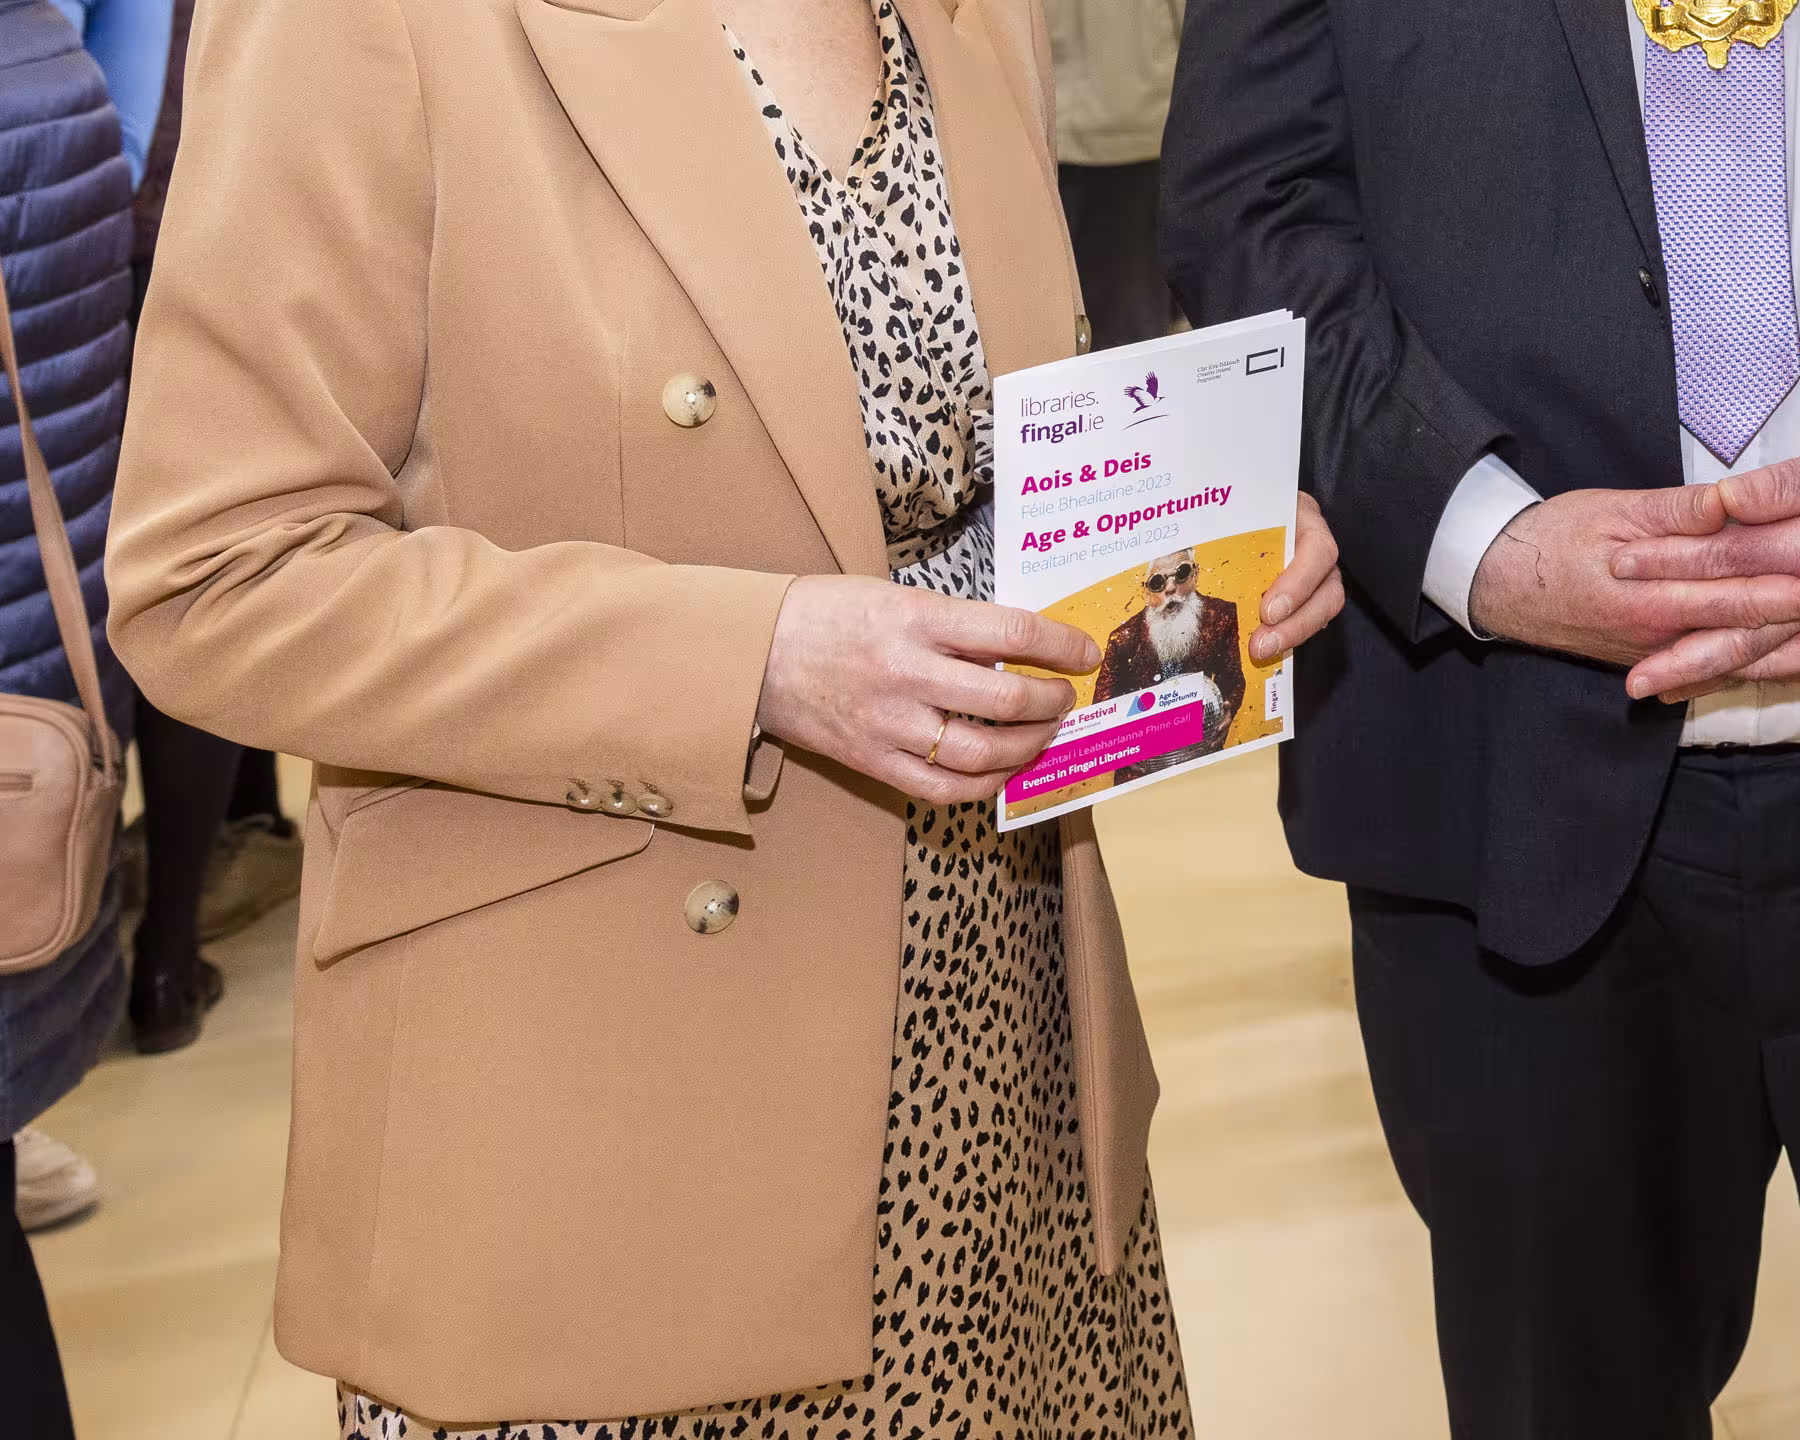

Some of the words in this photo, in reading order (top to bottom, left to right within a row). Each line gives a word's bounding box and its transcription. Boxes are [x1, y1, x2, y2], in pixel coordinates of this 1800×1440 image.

[1021, 391, 1100, 418] libraries.
[1020, 413, 1104, 444] fingal.ie
[1021, 469, 1073, 496] Aois
[1079, 464, 1097, 483] &
[1104, 452, 1152, 478] Deis
[1021, 500, 1055, 520] Féile
[1059, 483, 1134, 513] Bhealtaine
[1137, 472, 1172, 498] 2023
[1021, 527, 1067, 553] Age
[1072, 520, 1090, 539] &
[1096, 485, 1233, 535] Opportunity
[1021, 549, 1088, 576] Bealtaine
[1091, 533, 1141, 559] Festival
[1145, 523, 1180, 545] 2023
[1078, 704, 1117, 724] Festival
[1158, 692, 1172, 702] Age
[1172, 690, 1179, 698] &
[1158, 690, 1198, 708] Opportunity
[1078, 729, 1144, 758] Leabharlanna
[1145, 720, 1172, 737] Fhine
[1173, 713, 1191, 727] Gall
[1022, 770, 1056, 791] Events
[1057, 765, 1067, 780] in
[1068, 754, 1098, 778] Fingal
[1099, 744, 1141, 766] Libraries
